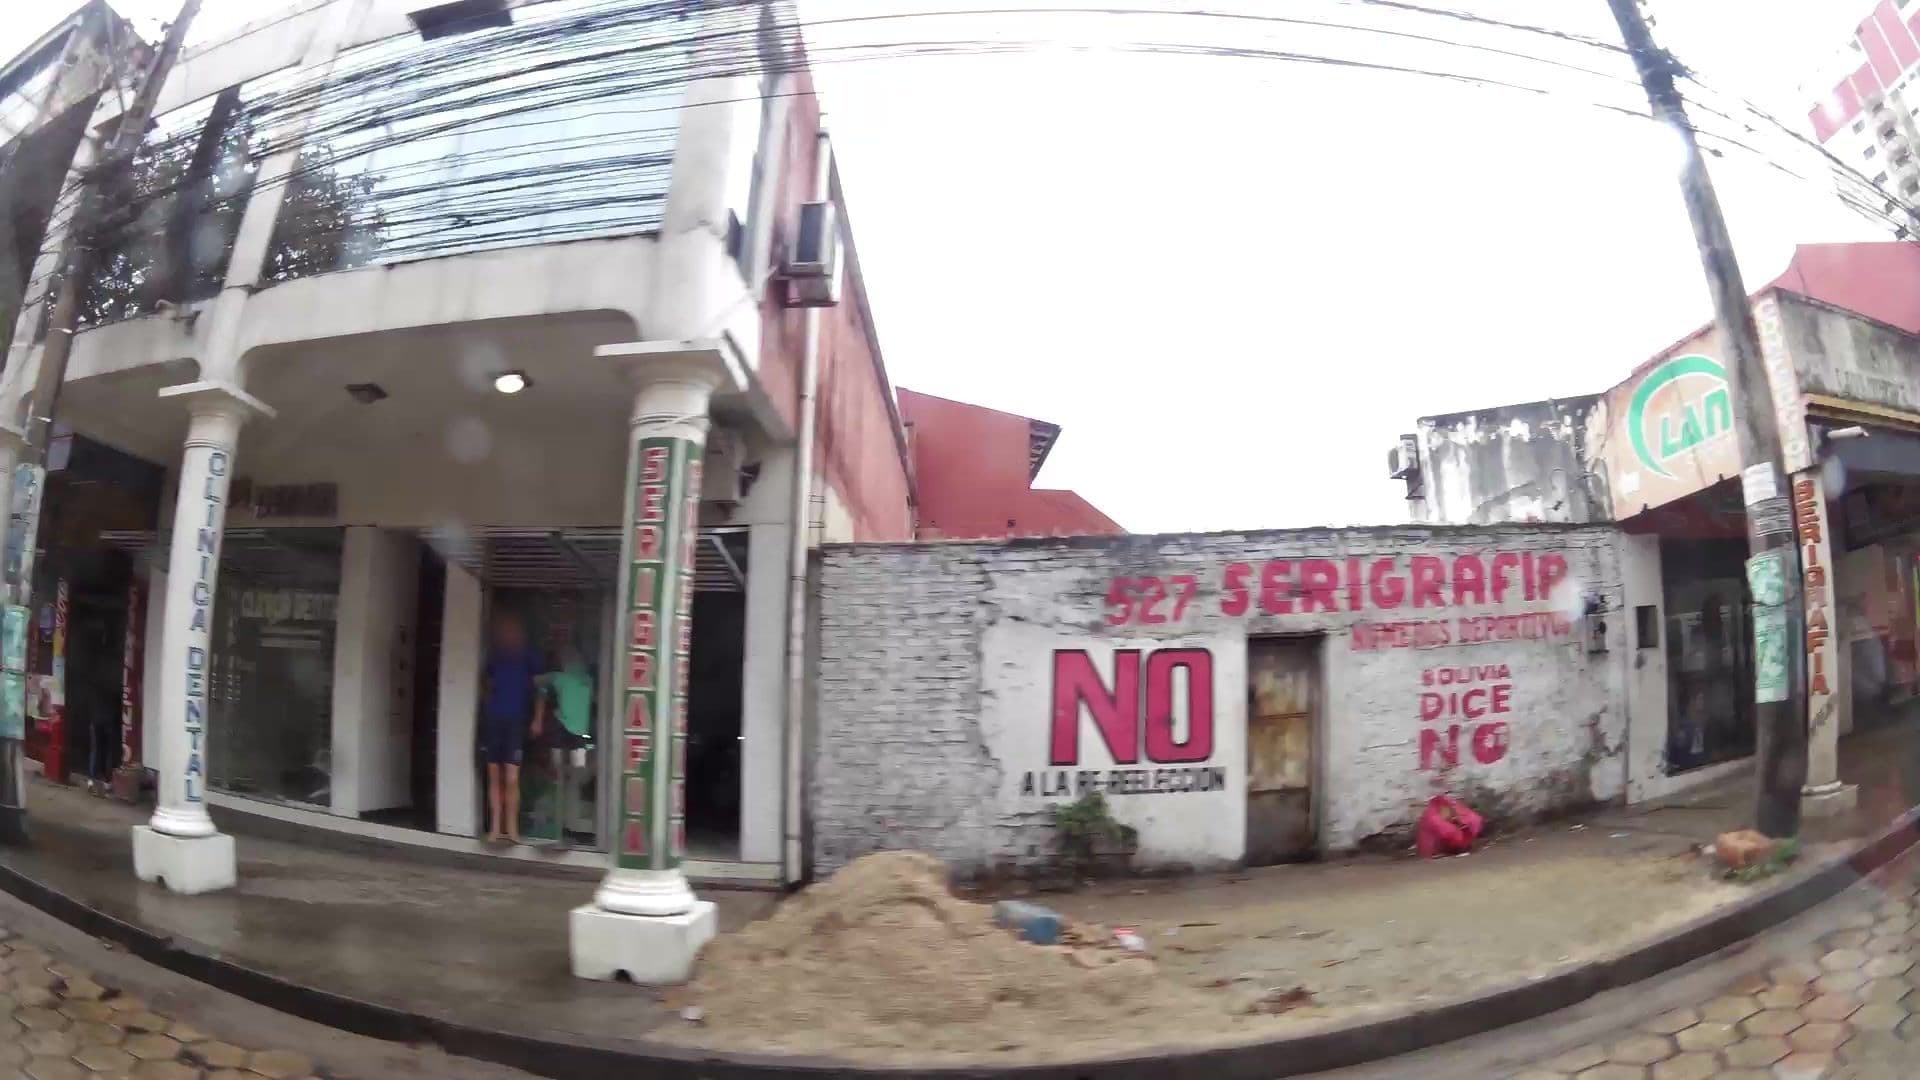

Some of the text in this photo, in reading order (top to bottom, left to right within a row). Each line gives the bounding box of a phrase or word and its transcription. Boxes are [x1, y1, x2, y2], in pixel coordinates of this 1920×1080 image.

[184, 452, 227, 801] CLINICA DENTAL
[622, 447, 669, 855] SERIGRAFIA
[1422, 663, 1511, 687] BOLIVIA
[1049, 647, 1215, 766] NO
[1420, 684, 1513, 721] DICE
[1419, 722, 1509, 771] NO
[1020, 771, 1036, 796] A
[1040, 771, 1073, 797] LA
